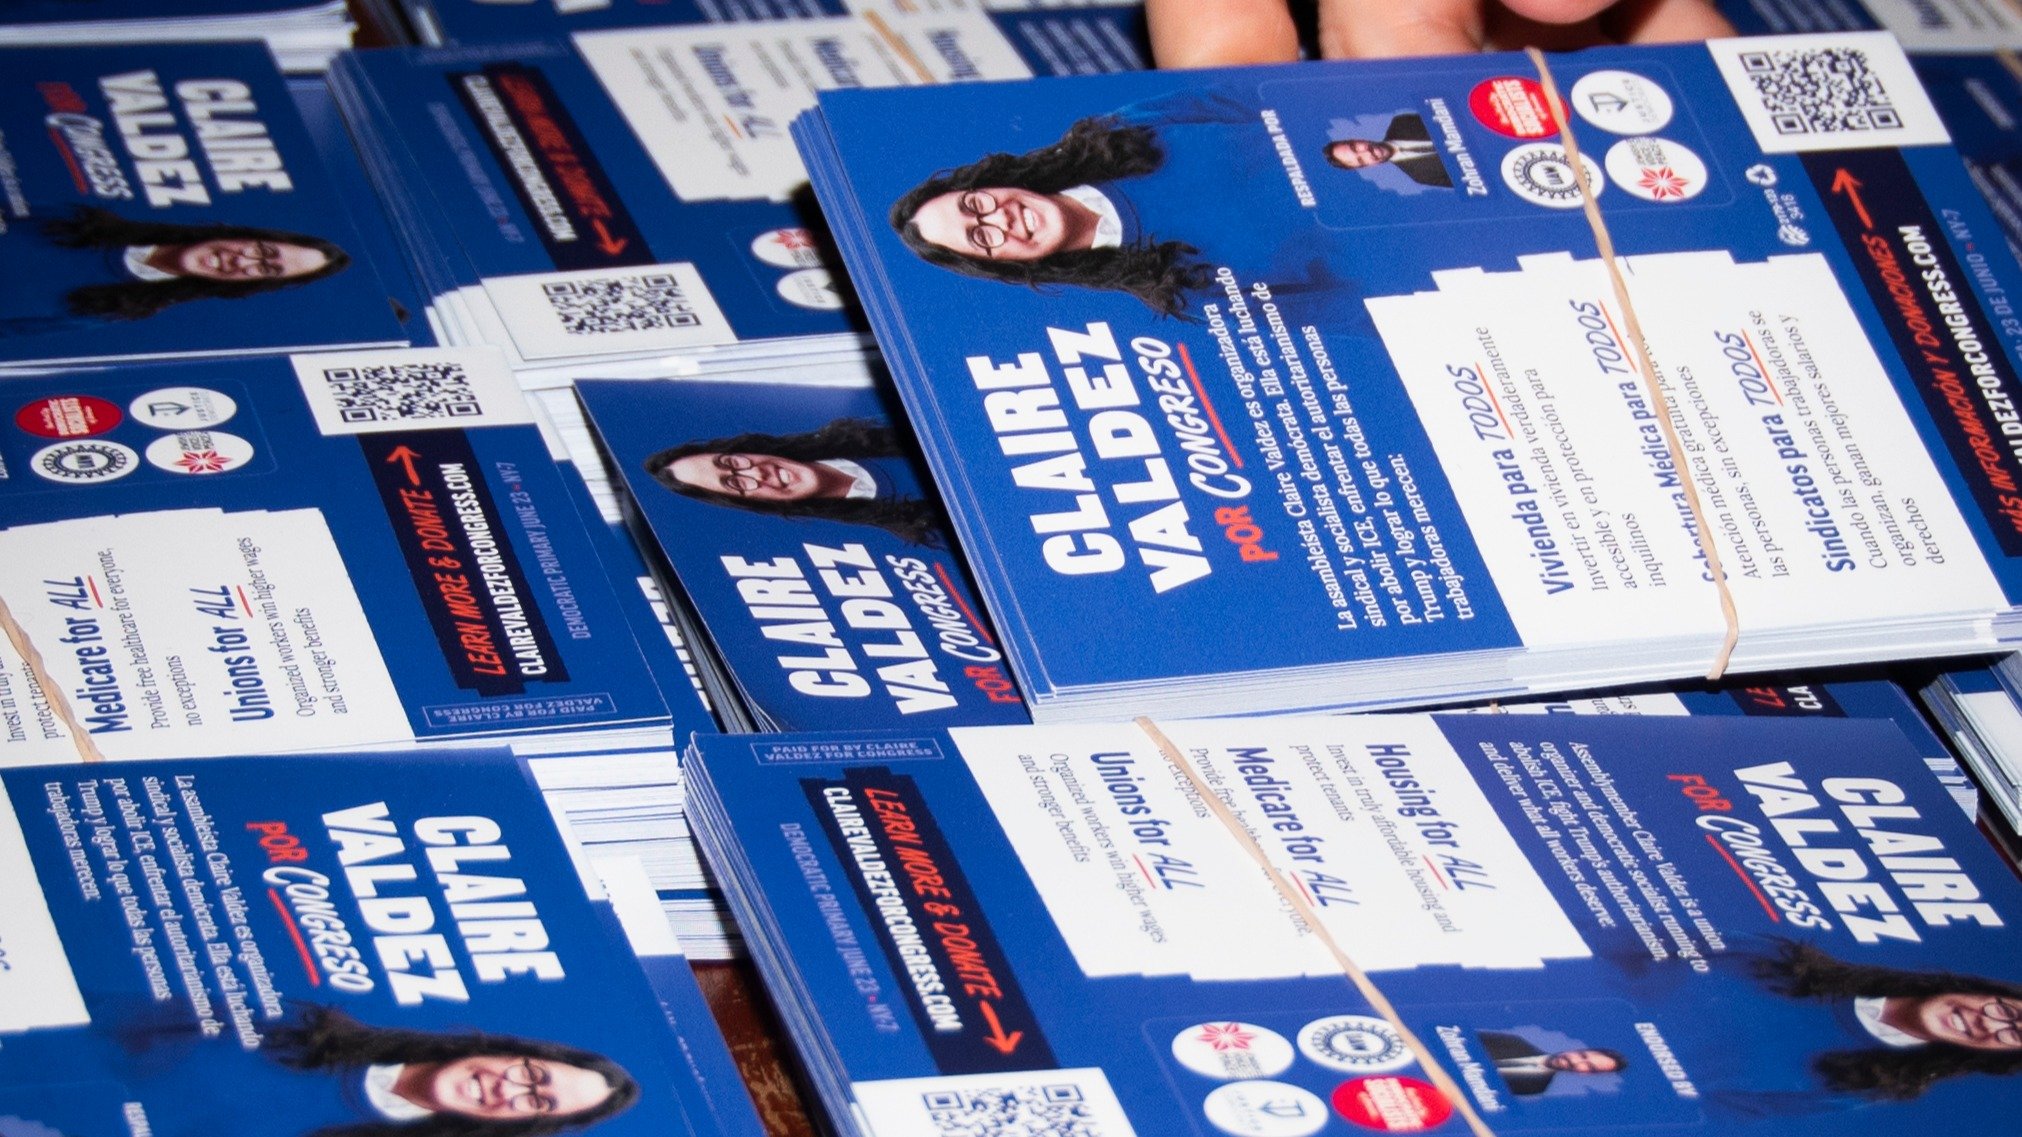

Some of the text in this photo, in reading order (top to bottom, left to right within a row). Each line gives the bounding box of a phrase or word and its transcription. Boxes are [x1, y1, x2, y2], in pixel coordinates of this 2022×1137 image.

[101, 72, 210, 206] VALDEZ
[177, 81, 292, 191] CLAIRE
[1261, 110, 1316, 206] RESPALDADA POR
[1425, 99, 1487, 195] Zohran Mamdani
[1942, 209, 1971, 240] NY-7
[1966, 253, 2004, 293] JUNIO
[1215, 267, 1257, 334] luchando
[1862, 234, 1940, 347] DONACIONES
[1989, 296, 2013, 315] DE
[2001, 318, 2022, 335] 23
[1241, 336, 1271, 366] está
[1259, 368, 1284, 396] Ella
[1302, 326, 1348, 391] personas
[1332, 394, 1352, 415] las
[1525, 369, 1555, 399] para
[1569, 300, 1682, 487] Médica para TODOS
[1785, 327, 1822, 379] salarios
[1923, 351, 1948, 364] Y
[966, 353, 1125, 575] CLAIRE
[1047, 322, 1212, 593] VALDEZ
[1131, 337, 1279, 562] POR CONGRESO
[1251, 282, 1422, 624] por abolir ICE, enfrentar el autoritarianismo de
[1276, 399, 1321, 481] demócrata.
[1343, 417, 1371, 458] todas
[1476, 327, 1608, 591] Invertir en vivienda verdaderamente
[1541, 404, 1593, 482] protección
[1714, 331, 1856, 572] Sindicatos para TODOS
[1749, 311, 1887, 568] Cuando las personas trabajadoras se
[1814, 383, 1852, 439] mejores
[1845, 443, 1882, 486] ganan
[1933, 368, 2016, 491] INFORMACIÓN
[1204, 304, 1357, 629] La asambleísta Claire Valdez es organizadora
[1313, 484, 1354, 553] socialista
[1362, 461, 1389, 489] que
[1374, 492, 1393, 507] lo
[1446, 365, 1574, 595] Vivienda para TODOS
[1580, 486, 1597, 504] en
[1677, 366, 1789, 577] las personas, sin excepciones
[1692, 456, 1724, 502] médica
[400, 489, 506, 675] LEARN MORE & DONATE
[439, 463, 547, 675] CLAIREVALDEZFORCONGRESS.COM
[496, 462, 591, 639] DEMOCRATIC PRIMARY JUNE 23 NY-7
[1383, 509, 1415, 555] lograr
[1421, 526, 1474, 619] trabajadoras
[1595, 521, 1637, 588] accesible
[1622, 513, 1666, 586] inquilinos
[1714, 504, 1761, 579] Atención
[1871, 491, 1916, 566] organizan,
[1902, 498, 1945, 564] derechos
[98, 548, 170, 729] Provide free healthcare for everyone,
[237, 537, 318, 716] Organized workers win higher wages
[720, 556, 871, 697] CLAIRE
[803, 543, 958, 714] VALDEZ
[886, 555, 1020, 703] FOR CONGRESS
[1344, 569, 1386, 627] sindical
[1411, 570, 1444, 622] Trump
[44, 577, 132, 734] Medicare for ALL
[166, 655, 202, 726] no exceptions
[190, 586, 274, 721] Unions for ALL
[293, 608, 347, 713] and stronger benefits
[1090, 752, 1203, 890] Unions for ALL
[1227, 748, 1358, 907] Medicare for ALL
[1366, 745, 1495, 890] Housing for ALL
[1667, 775, 1732, 811] FOR
[322, 802, 469, 1005] VALDEZ
[414, 816, 565, 982] CLAIRE
[865, 788, 1002, 998] LEARN MORE & DONATE
[1696, 815, 1832, 930] CONGRESS
[1734, 762, 1921, 942] VALDEZ
[1822, 778, 2004, 926] CLAIRE
[246, 822, 374, 992] POR CONGRESO
[823, 788, 963, 1030] CLAIREVALDEZFORCONGRESS.COM
